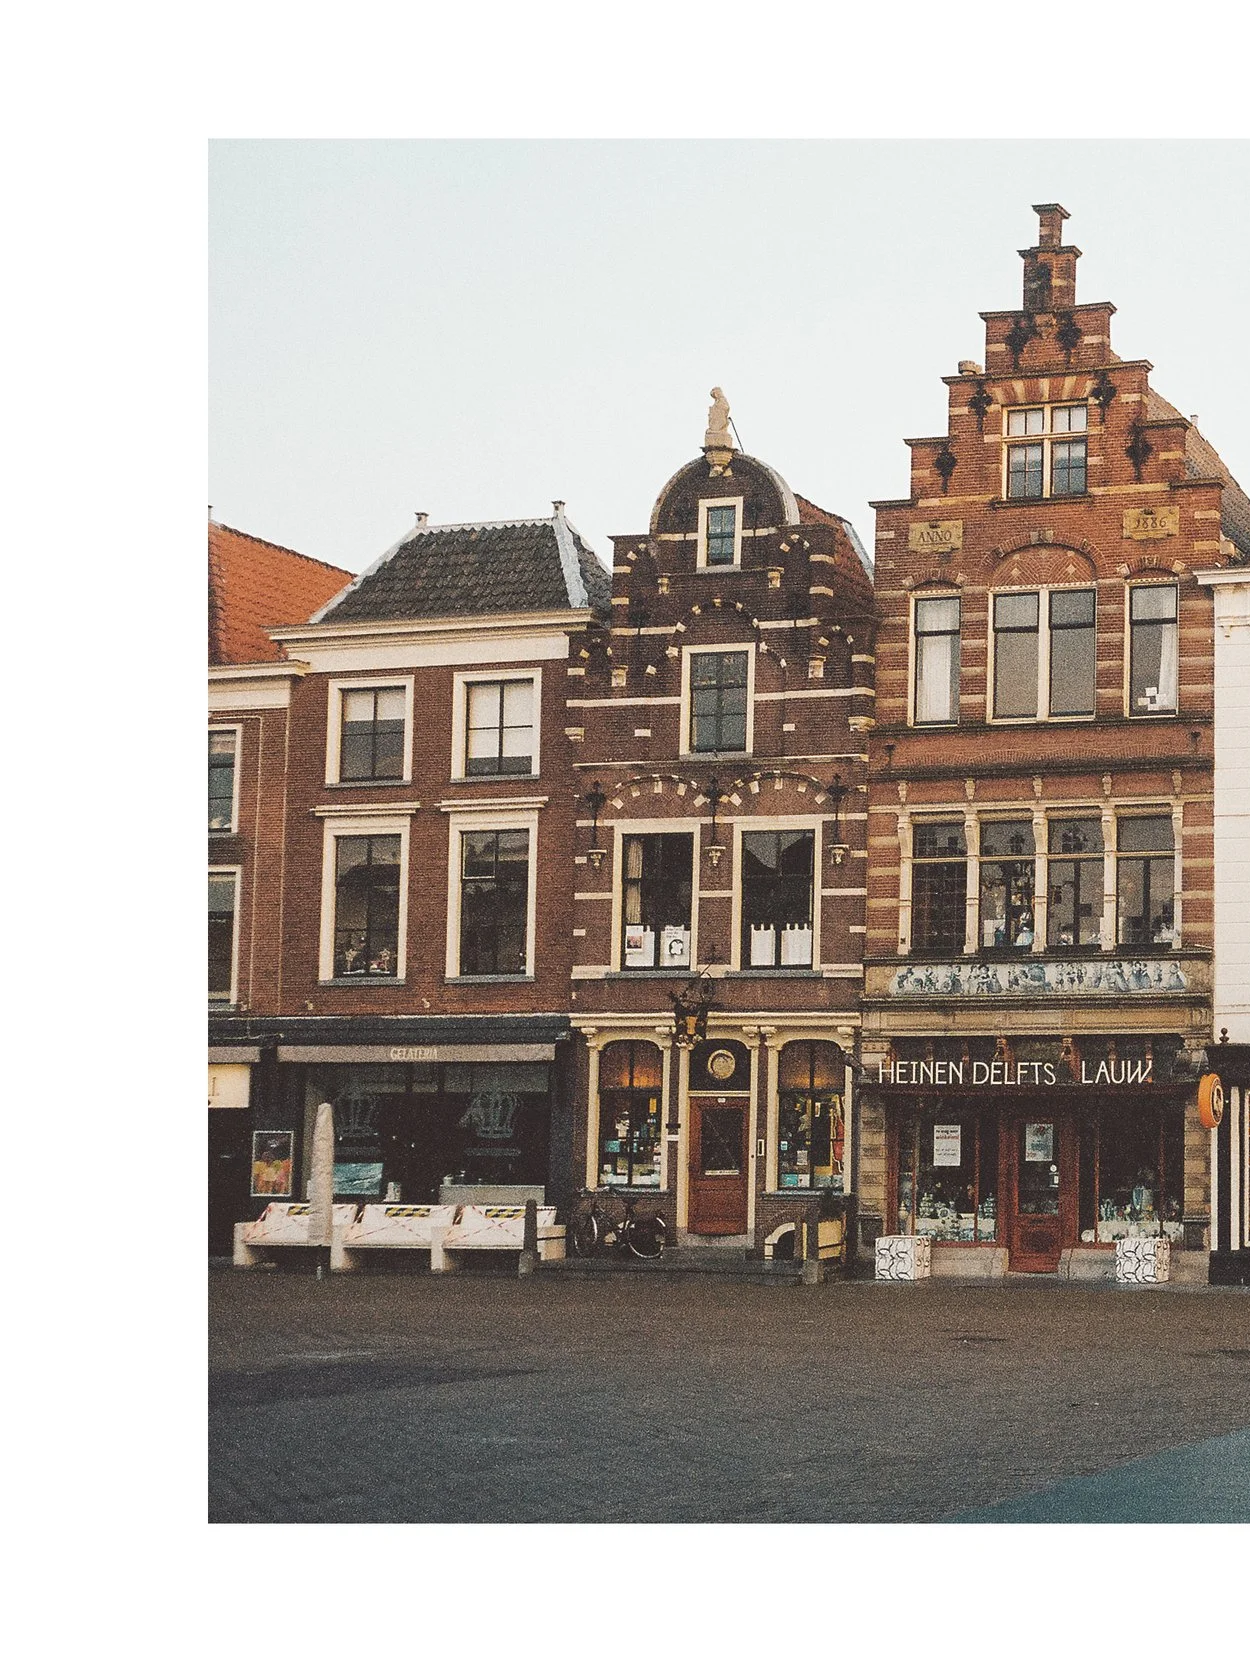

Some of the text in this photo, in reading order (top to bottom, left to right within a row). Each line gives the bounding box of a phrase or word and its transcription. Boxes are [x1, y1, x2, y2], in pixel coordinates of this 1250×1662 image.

[1133, 516, 1167, 529] 1886
[918, 530, 952, 543] ANNO
[878, 1060, 964, 1085] HEINEN
[972, 1061, 1057, 1086] DELFTS
